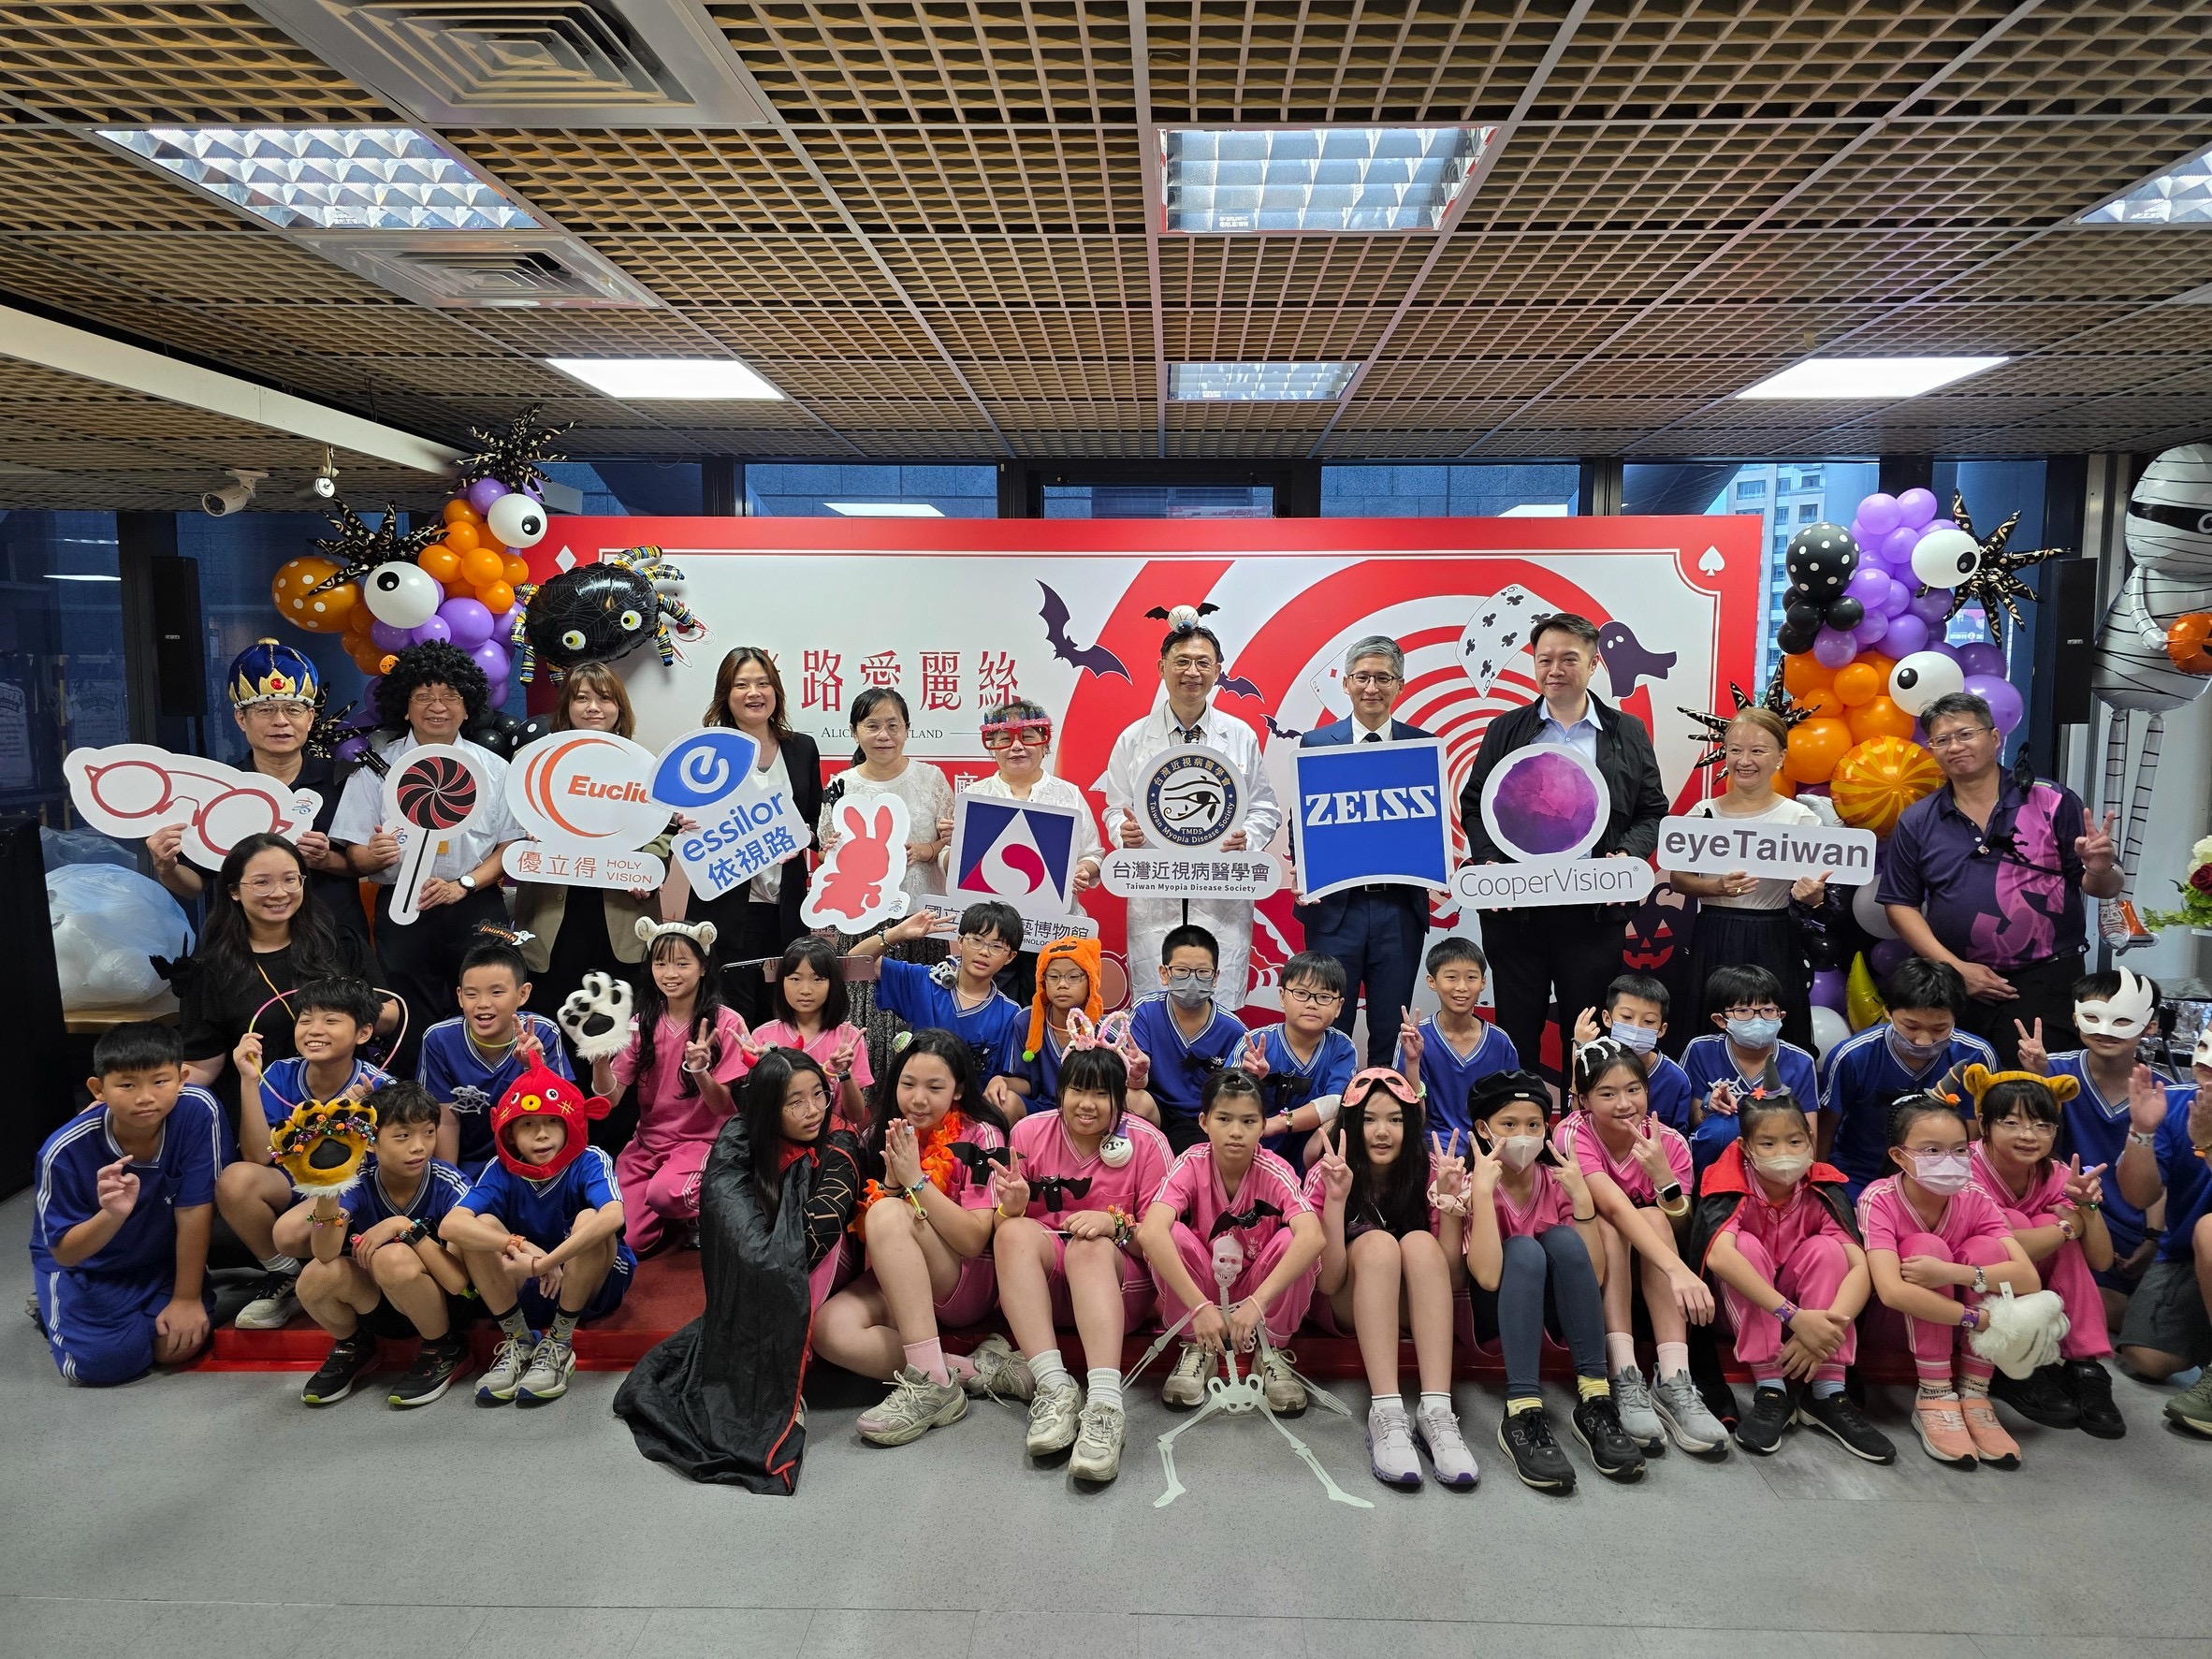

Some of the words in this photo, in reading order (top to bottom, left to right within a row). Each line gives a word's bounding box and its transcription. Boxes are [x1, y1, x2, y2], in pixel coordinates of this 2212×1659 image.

[762, 649, 1021, 712] 路愛麗絲
[821, 727, 853, 738] ALIC
[907, 729, 943, 739] TLAND
[1153, 756, 1231, 787] 台灣近視病醫學會
[1305, 785, 1437, 827] ZEISS
[682, 792, 784, 863] essilor
[1149, 801, 1162, 828] Taiwan
[1161, 826, 1189, 844] Myopia
[1192, 827, 1219, 843] Disease
[1218, 801, 1235, 829] Society
[606, 858, 643, 870] HOLY
[707, 824, 797, 891] 依視路
[1665, 829, 1870, 868] eyeTaiwan
[517, 851, 597, 880] 優立得
[606, 871, 653, 884] VISION
[1112, 860, 1271, 882] 台灣近視病醫學會
[1126, 882, 1156, 891] Taiwan
[1157, 883, 1188, 892] Myopia
[1190, 883, 1223, 892] Disease
[1224, 884, 1257, 893] Society
